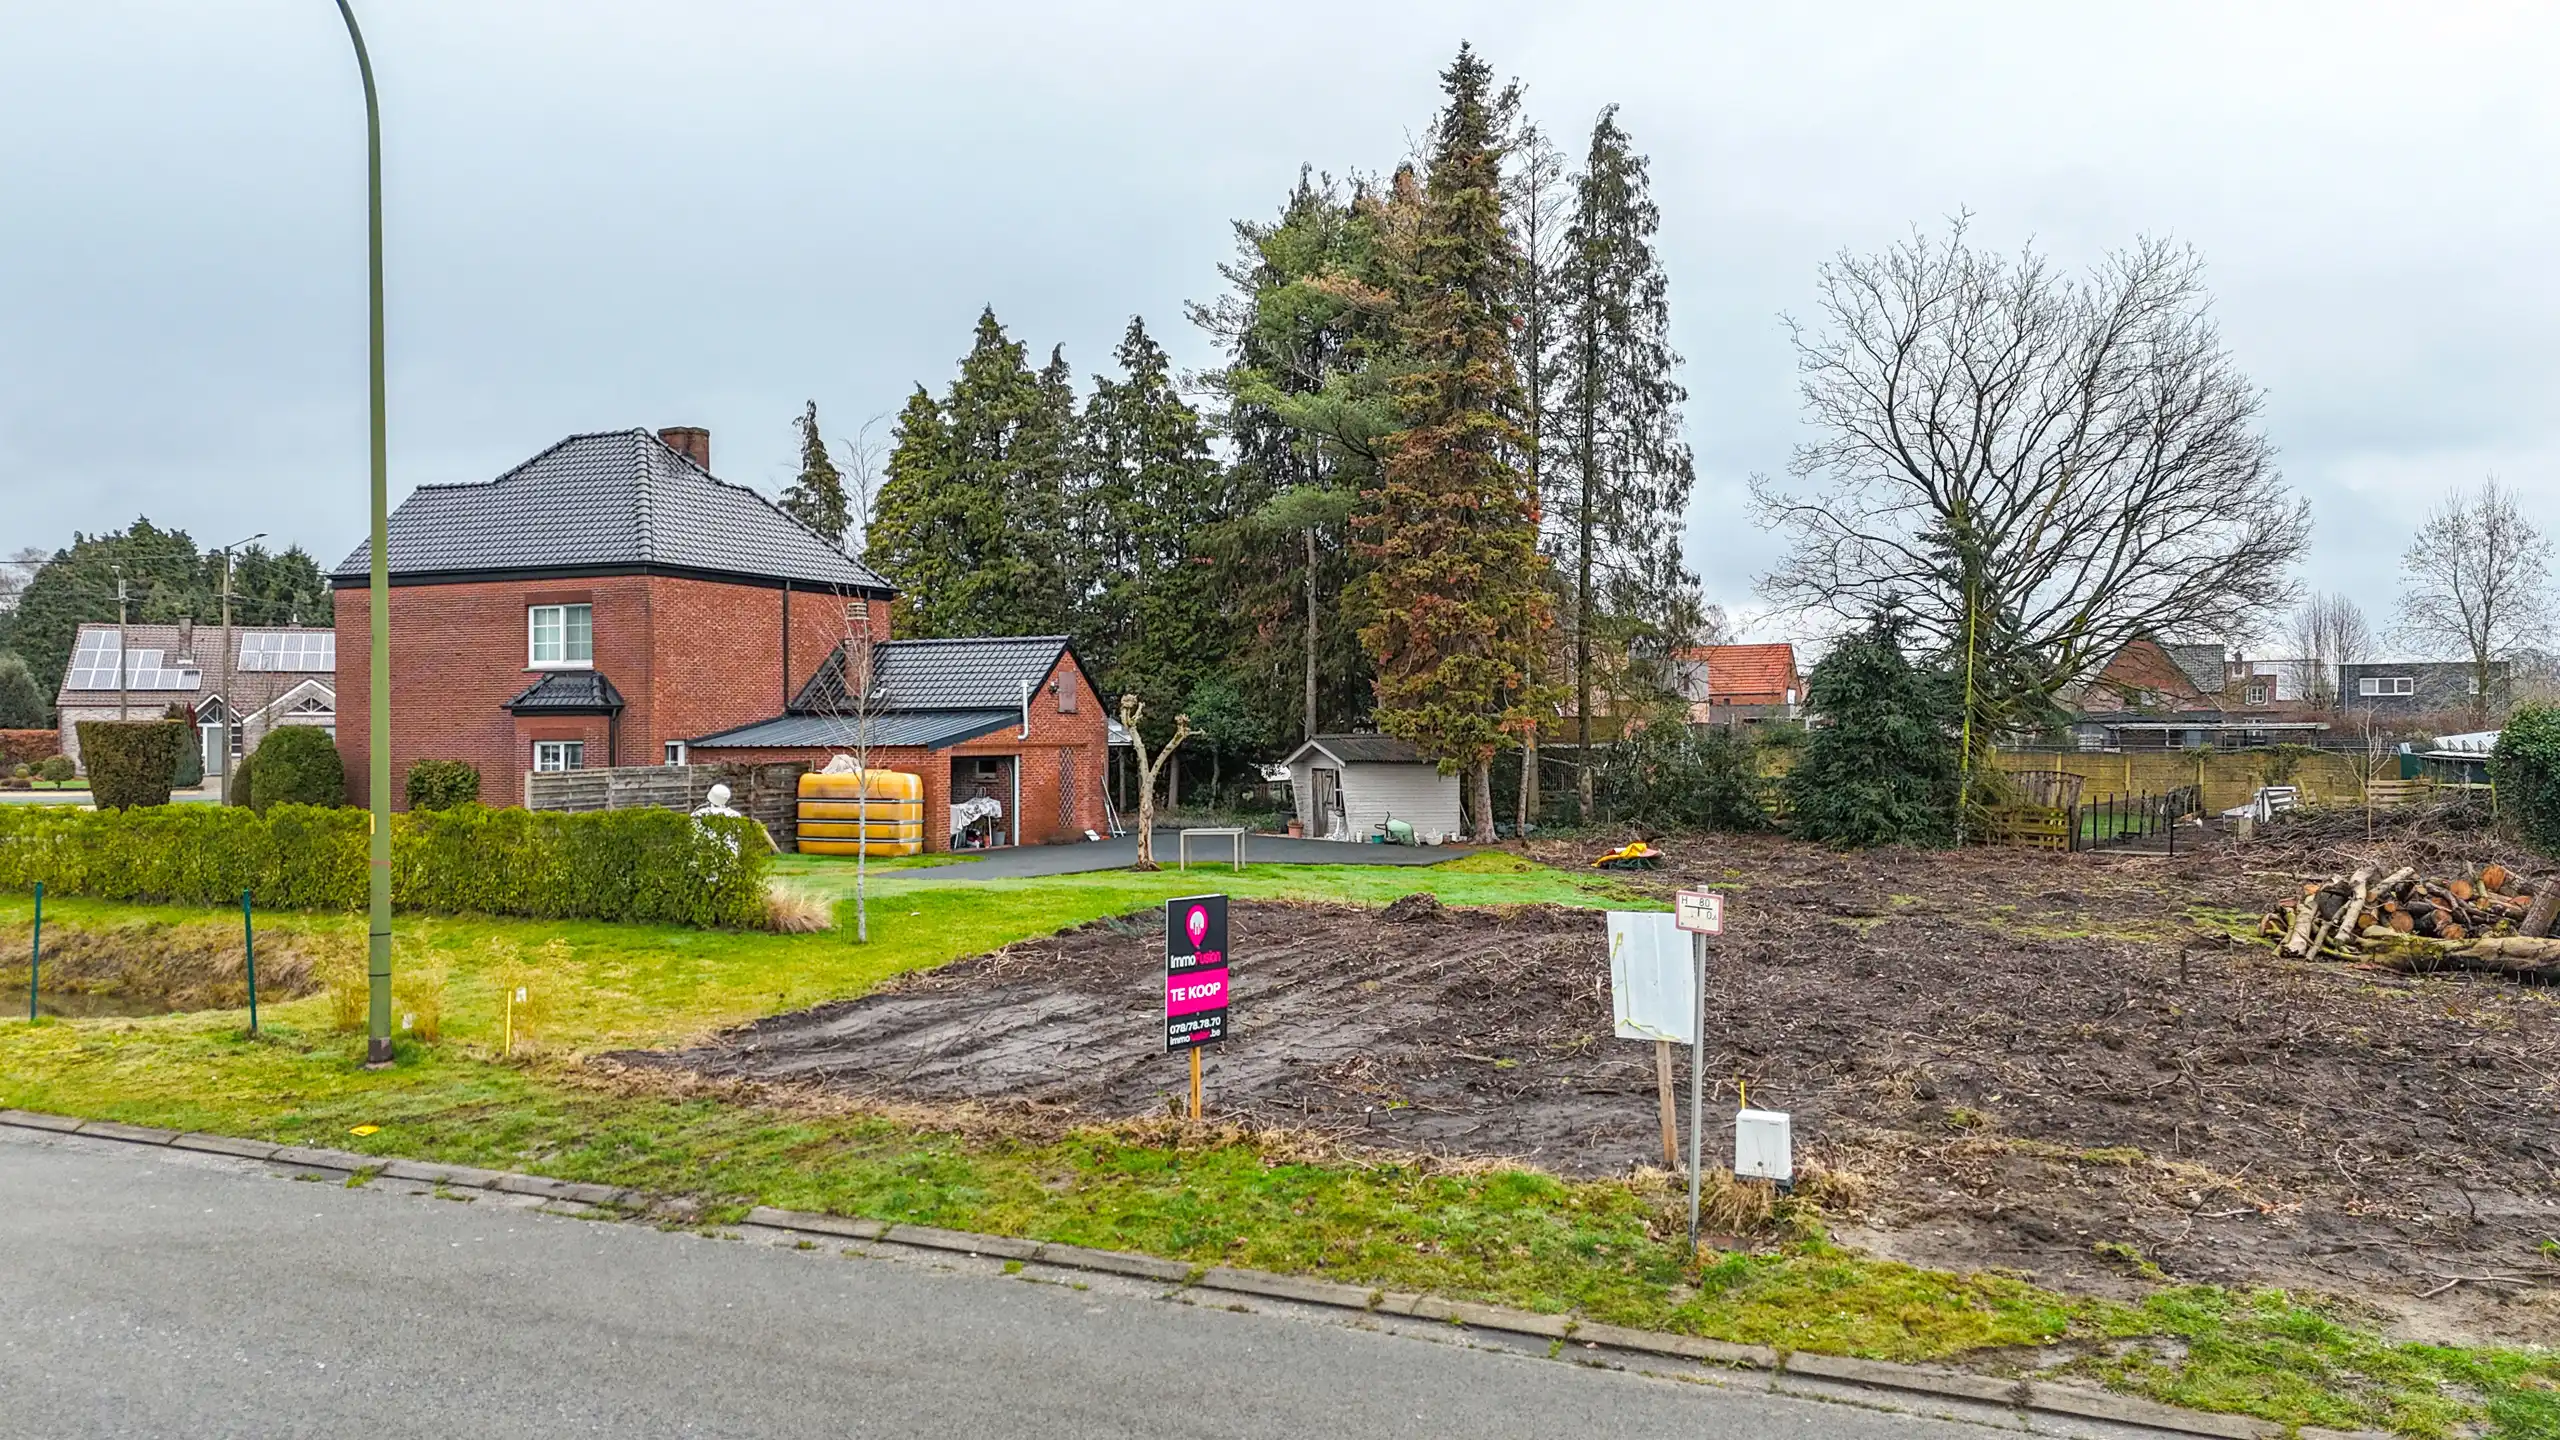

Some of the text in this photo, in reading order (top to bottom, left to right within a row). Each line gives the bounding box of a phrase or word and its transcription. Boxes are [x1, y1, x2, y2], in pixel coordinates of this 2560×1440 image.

[1681, 896, 1711, 907] H 80
[1170, 950, 1222, 969] ImmoFusion
[1170, 982, 1221, 1002] TE KOOP
[1169, 1016, 1221, 1035] 078/78.78.70
